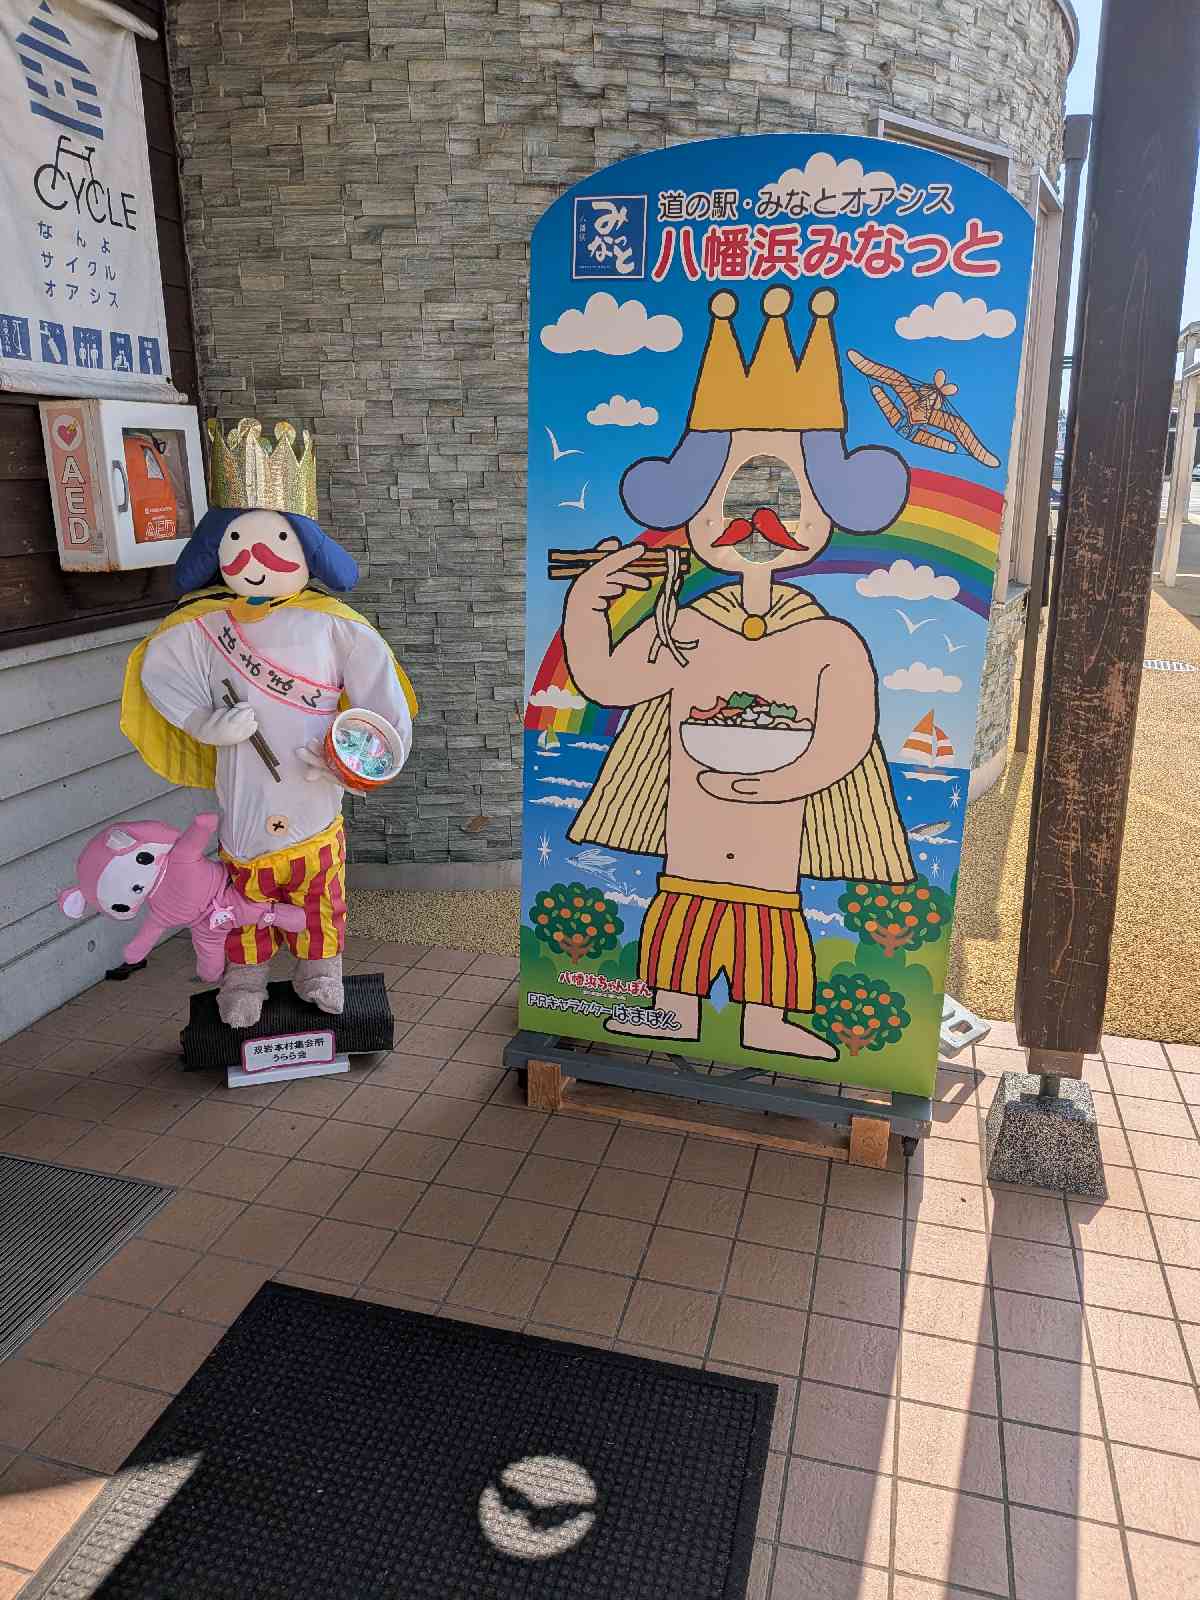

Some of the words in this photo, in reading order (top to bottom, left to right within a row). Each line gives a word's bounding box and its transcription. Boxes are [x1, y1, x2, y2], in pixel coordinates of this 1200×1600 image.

[34, 163, 137, 231] CYCLE
[656, 182, 955, 221] 道の駅・みなとオアシス
[41, 251, 116, 281] サイクル
[651, 217, 1003, 282] 八幡浜みなっと
[44, 280, 119, 308] オアシス
[62, 456, 90, 545] AED
